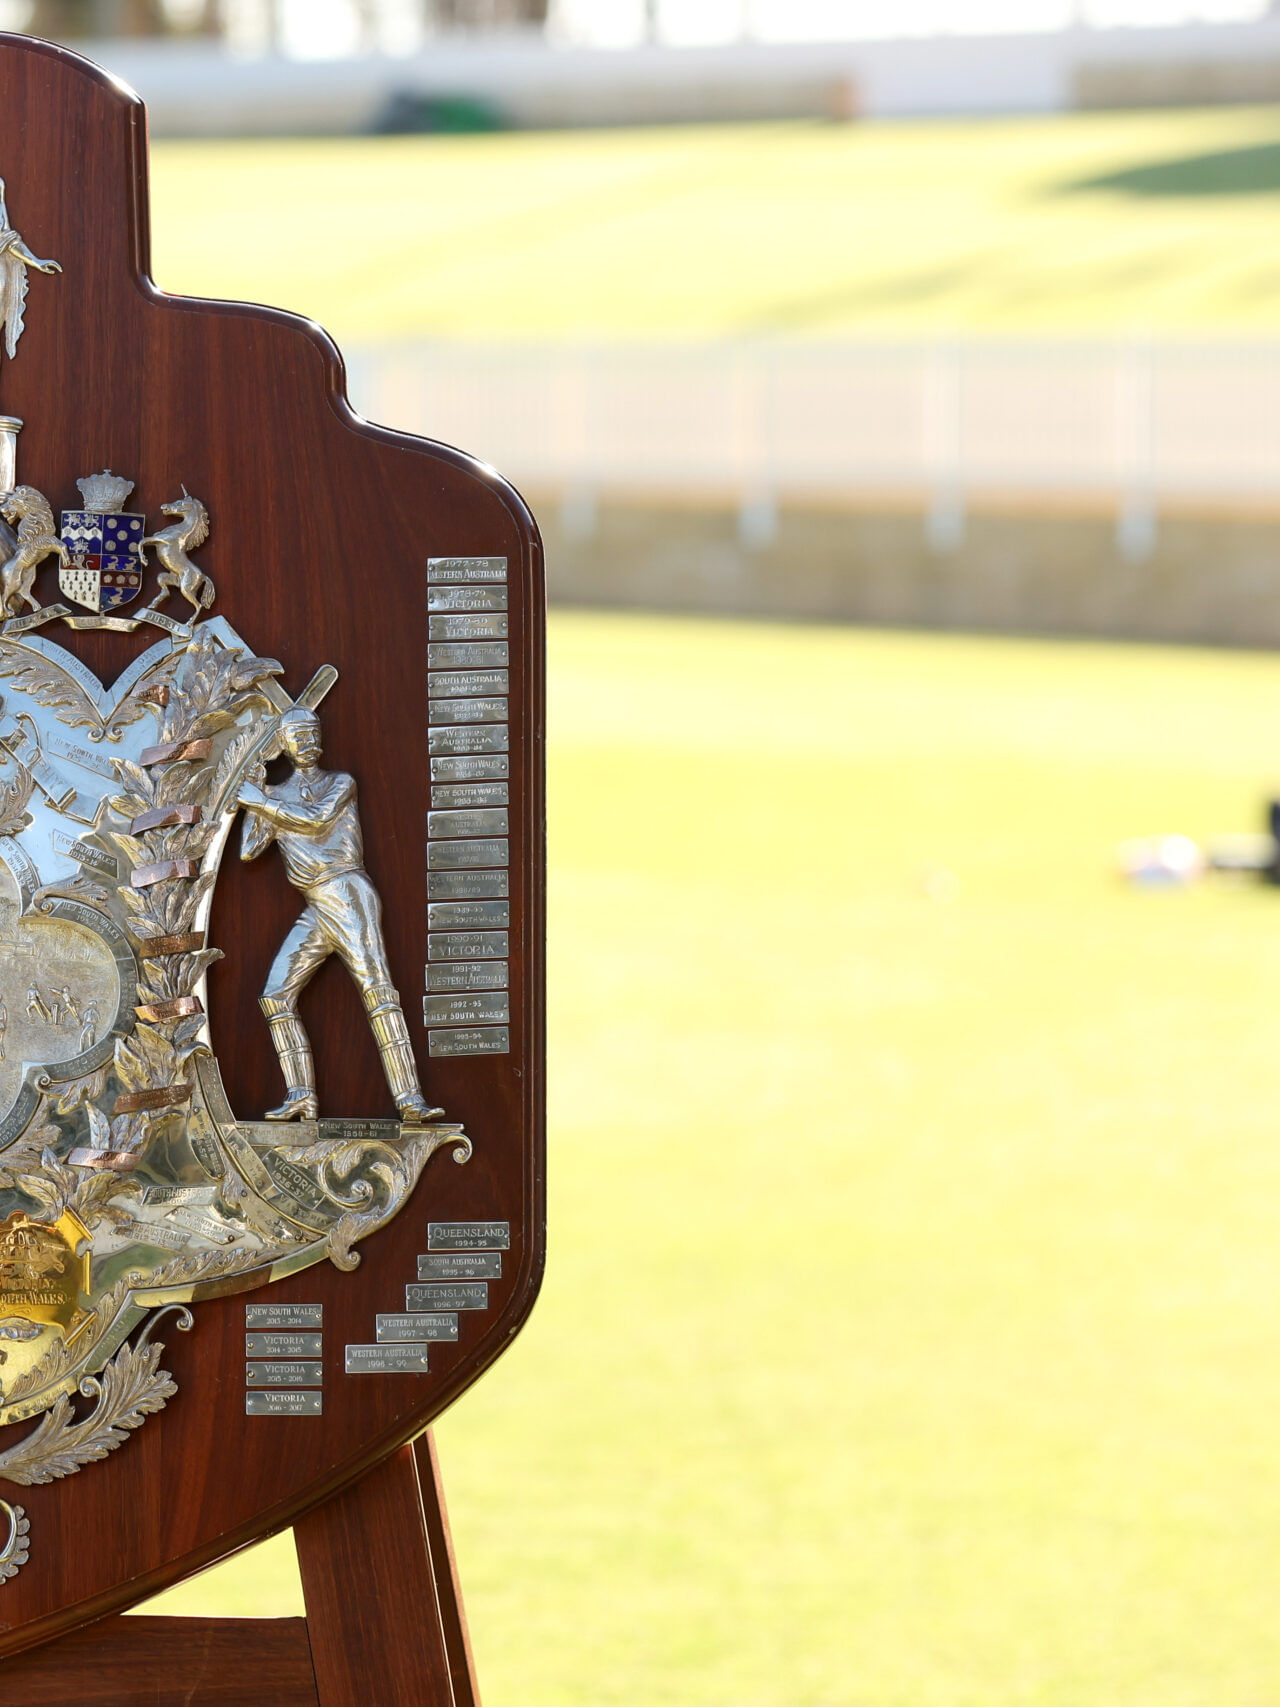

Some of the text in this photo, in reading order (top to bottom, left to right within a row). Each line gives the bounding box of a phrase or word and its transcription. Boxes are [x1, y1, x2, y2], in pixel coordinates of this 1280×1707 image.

[464, 569, 506, 579] AUSTRALIA
[444, 599, 493, 609] VICTORIA
[445, 627, 495, 637] VICTORIA
[435, 674, 502, 686] SOUTH AUSTRALIA
[477, 702, 504, 711] WALES
[441, 737, 493, 747] AUSTRALIA
[439, 759, 500, 770] NEW SOUTH WALES
[435, 790, 450, 798] NEW
[452, 788, 476, 797] SOUTH
[467, 873, 506, 881] AUSTRALIA
[454, 916, 478, 924] SOUTH
[439, 944, 496, 957] VICTORIA
[431, 975, 468, 986] WESTERN
[430, 1010, 504, 1021] NEW SOUTH WALES
[454, 1041, 501, 1050] SOUTH WALES
[324, 1121, 340, 1129] NEW
[343, 1121, 367, 1129] SOUTH
[273, 1159, 317, 1198] VICTORIA
[434, 1227, 505, 1241] QUEENSLAND
[428, 1257, 487, 1266] SOUTH AUSTRALIA
[411, 1288, 482, 1302] QUEENSLAND
[250, 1307, 317, 1316] NEW SOUTH WALES
[382, 1318, 454, 1327] WESTERN AUSTRALIA
[399, 1329, 438, 1337] 1997 98
[263, 1336, 305, 1345] VICTORIA
[351, 1349, 423, 1358] WESTERN AUSTRALIA
[367, 1360, 385, 1369] 1998
[264, 1365, 306, 1374] VICTORIA
[264, 1393, 306, 1402] VICTORIA
